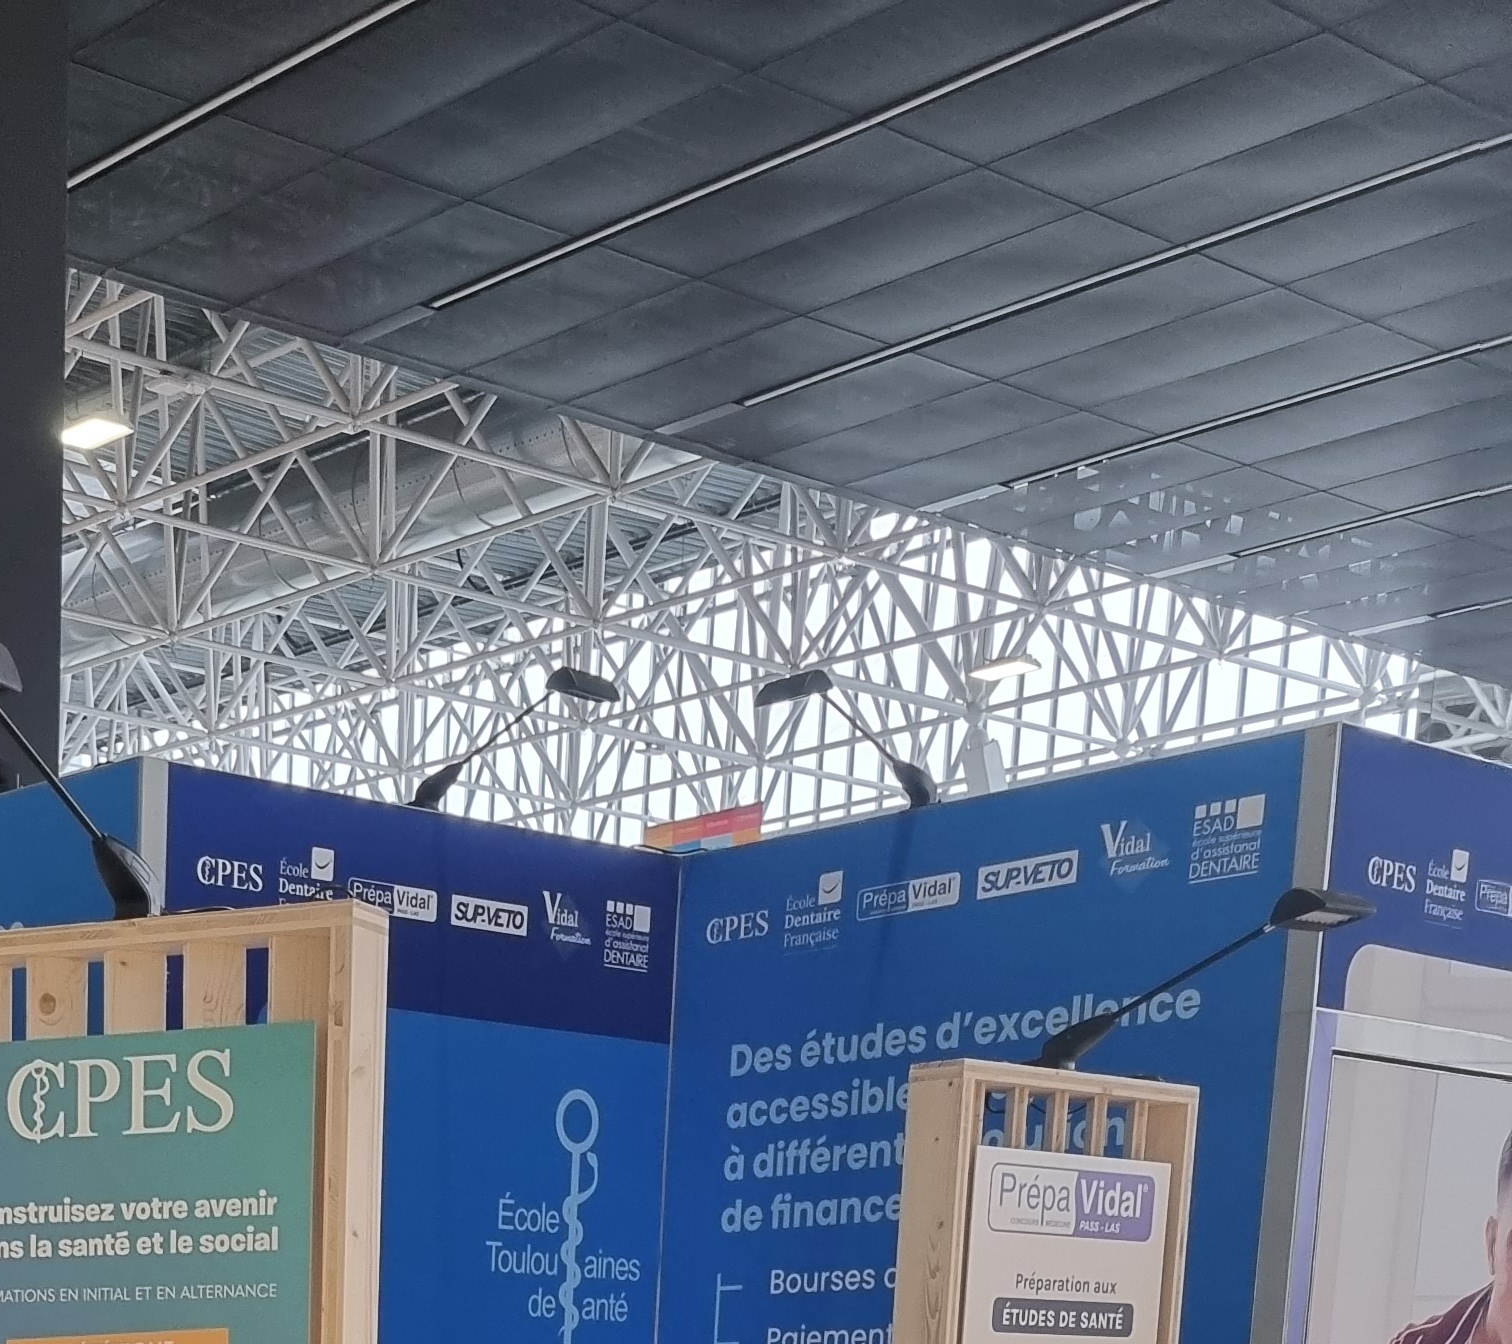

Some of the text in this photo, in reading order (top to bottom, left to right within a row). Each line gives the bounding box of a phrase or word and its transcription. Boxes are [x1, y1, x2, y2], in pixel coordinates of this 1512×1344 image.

[1100, 820, 1152, 859] Vidal
[1193, 816, 1235, 837] ESAD
[196, 856, 263, 893] CPES
[280, 857, 309, 879] École
[1110, 855, 1170, 877] Formation
[1189, 852, 1260, 879] DENTAIRE
[1368, 856, 1417, 893] CPES
[1427, 859, 1450, 880] École
[353, 881, 392, 908] Prépa
[786, 895, 816, 912] École
[862, 888, 906, 912] Prépa
[1425, 879, 1466, 902] Dentaire
[543, 890, 579, 928] Vidal
[605, 913, 633, 931] ESAD
[784, 908, 841, 930] Dentaire
[1424, 898, 1464, 921] Française
[550, 927, 592, 945] Formation
[706, 909, 769, 945] CPES
[783, 926, 839, 949] Française
[603, 948, 648, 969] DENTAIRE
[729, 1042, 792, 1078] Des
[800, 1021, 927, 1067] études
[7, 1048, 234, 1143] CPES
[724, 1144, 744, 1181] à
[120, 1198, 188, 1221] votre
[194, 1189, 278, 1218] avenir
[999, 1172, 1070, 1224] Prépa
[498, 1191, 560, 1234] École
[721, 1199, 763, 1233] de
[30, 1234, 52, 1258] la
[58, 1230, 130, 1257] santé
[137, 1231, 163, 1255] et
[170, 1229, 193, 1254] le
[199, 1225, 279, 1252] social
[60, 1288, 78, 1302] EN
[83, 1287, 130, 1301] INITIAL
[135, 1286, 152, 1301] ET
[156, 1285, 176, 1300] EN
[180, 1283, 278, 1300] ALTERNANCE
[770, 1267, 876, 1295] Bourses
[1015, 1272, 1117, 1295] Préparation aux
[528, 1287, 556, 1318] de
[1002, 1302, 1124, 1330] ÉTUDES DE SANTÉ
